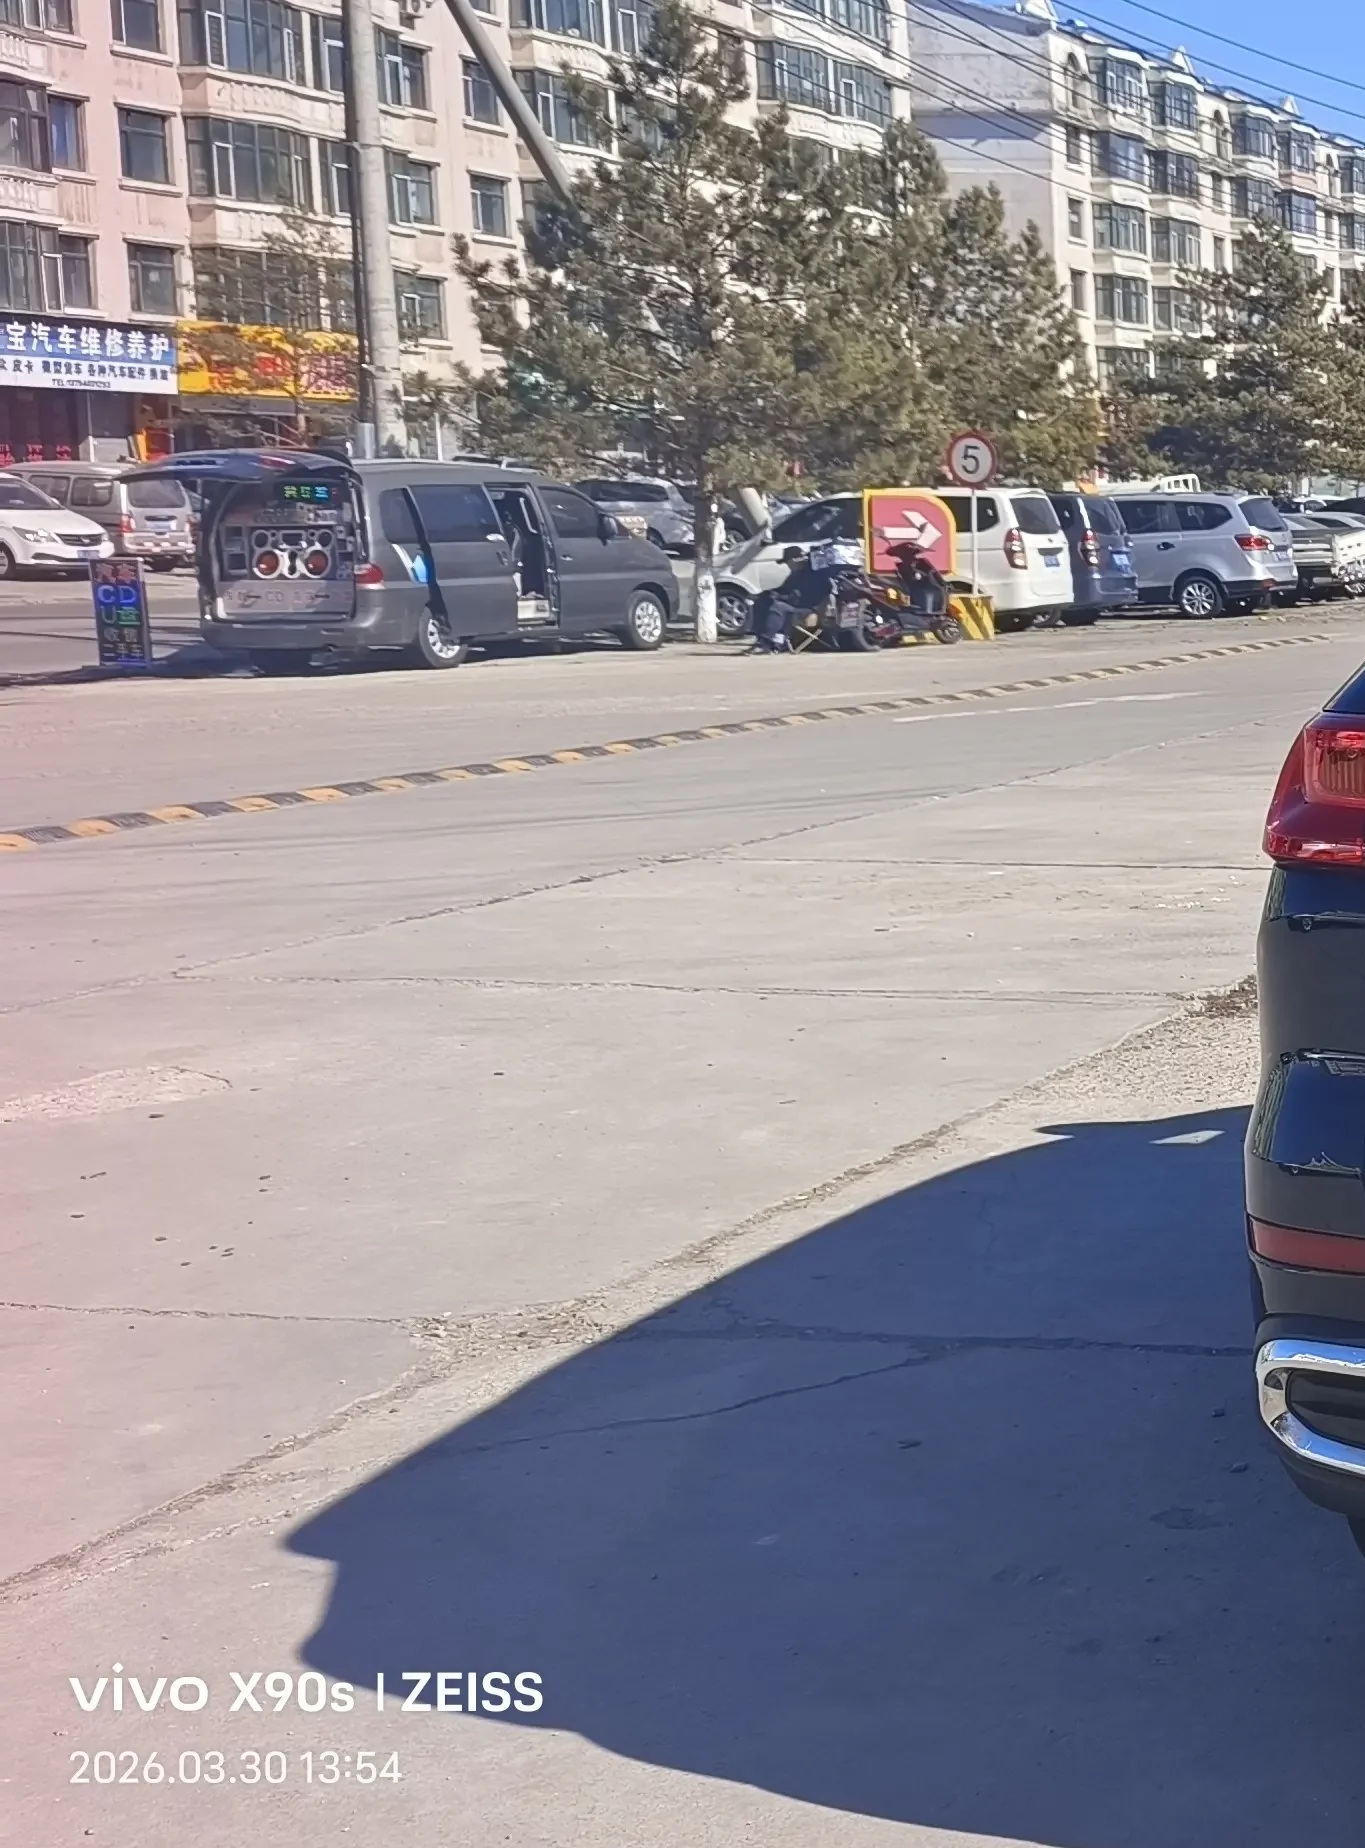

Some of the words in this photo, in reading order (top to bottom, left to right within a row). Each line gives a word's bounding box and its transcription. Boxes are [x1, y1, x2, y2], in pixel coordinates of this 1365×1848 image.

[0, 320, 170, 362] 宝汽车维修养护
[961, 444, 980, 474] 5
[97, 584, 137, 603] CD
